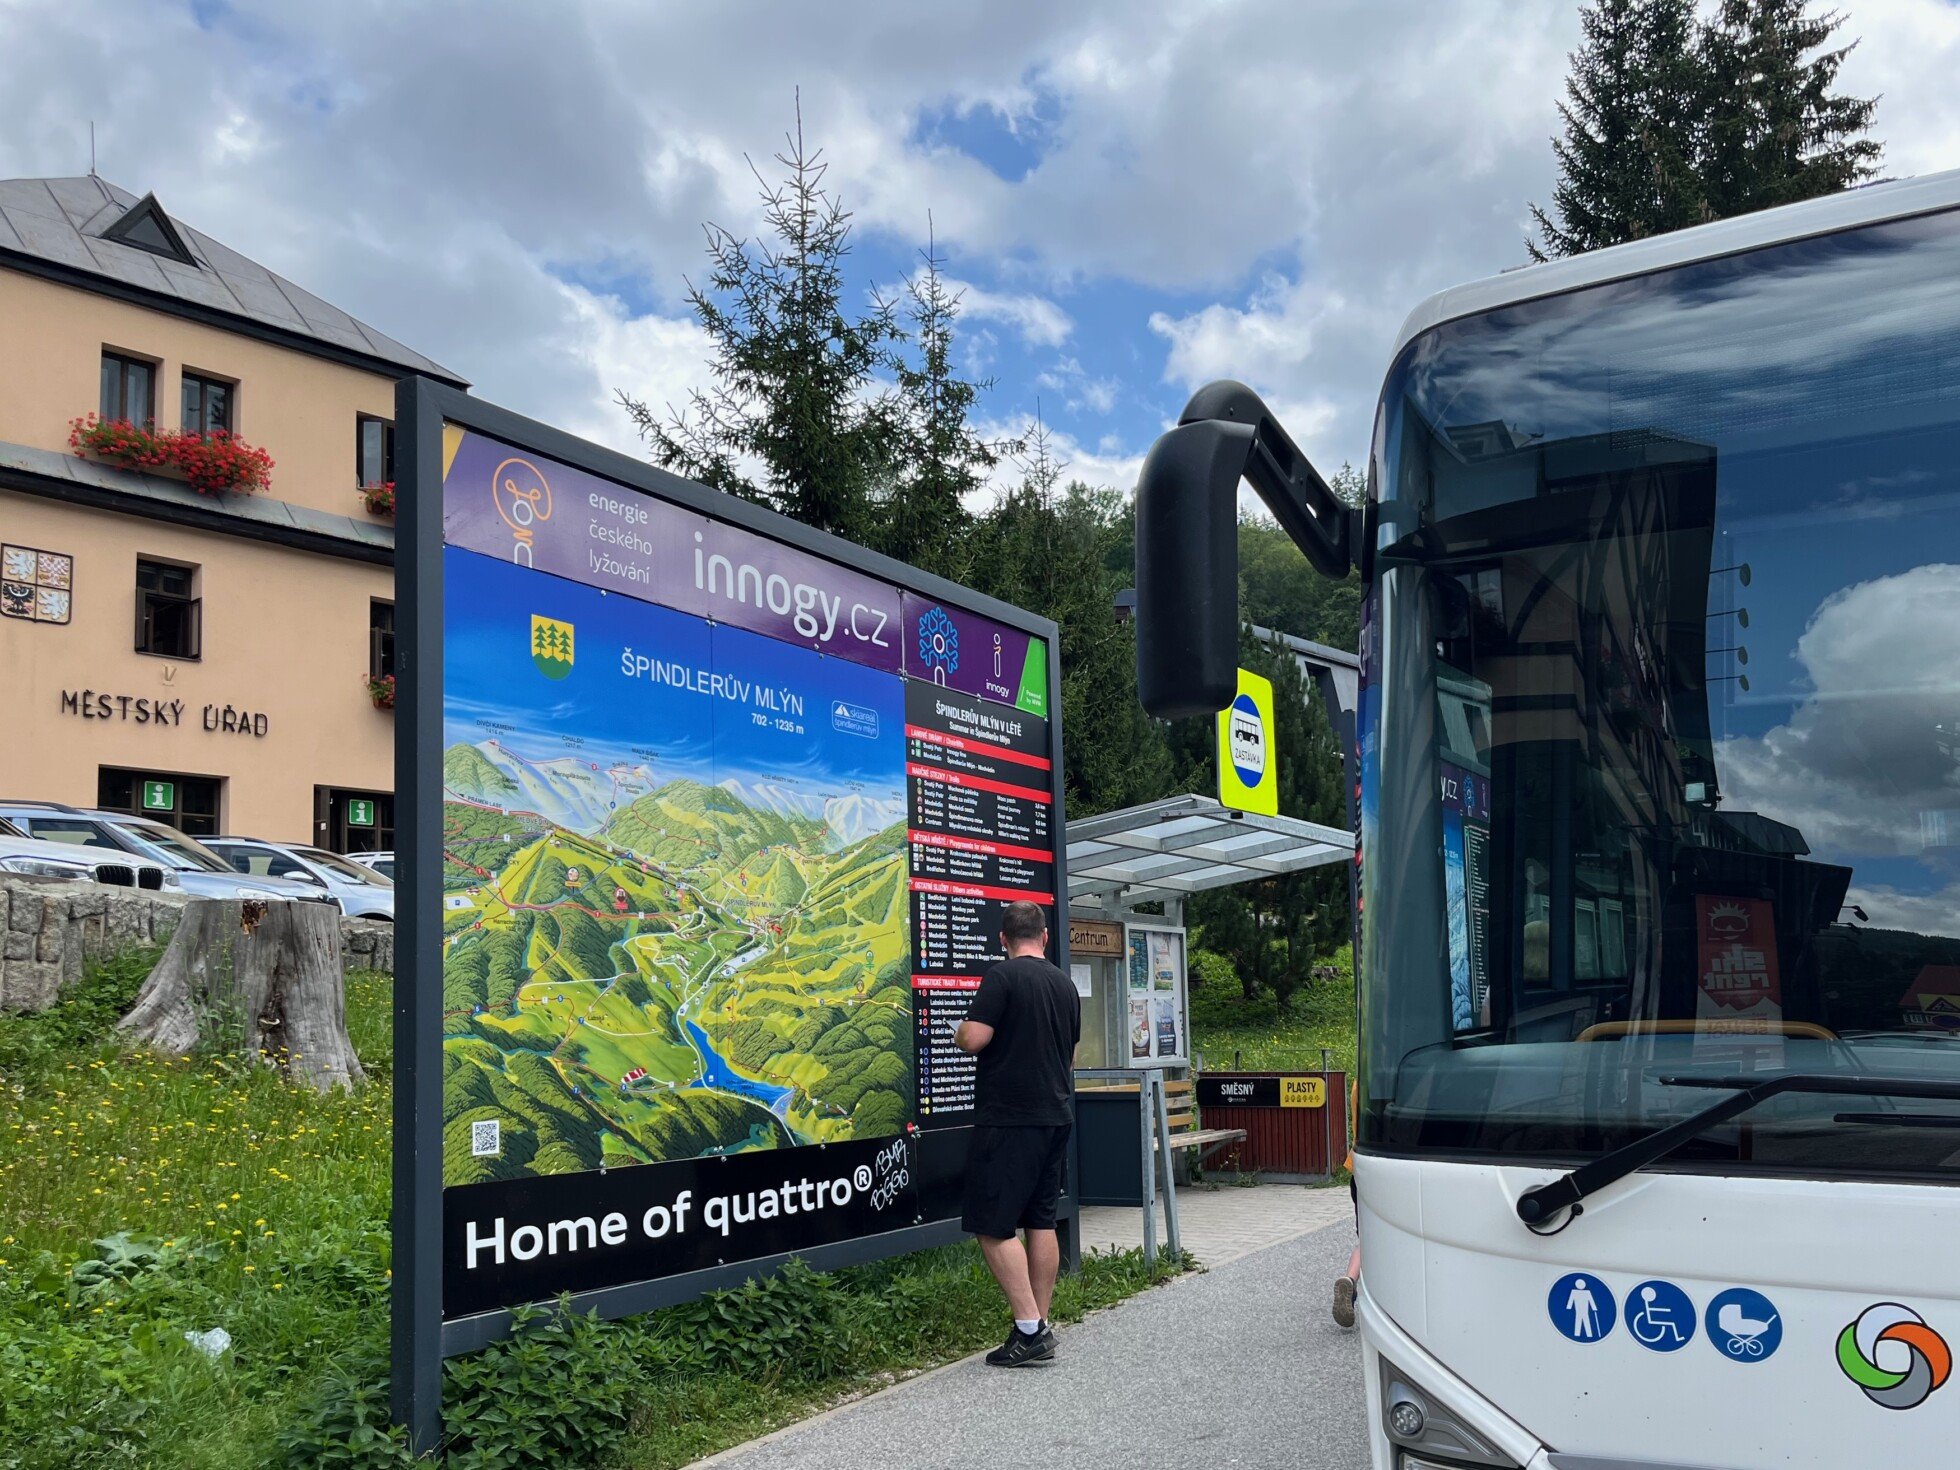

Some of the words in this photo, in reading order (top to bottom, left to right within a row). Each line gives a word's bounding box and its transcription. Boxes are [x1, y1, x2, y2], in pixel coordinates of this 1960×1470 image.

[589, 493, 648, 524] energie
[590, 519, 652, 555] českého
[590, 549, 649, 584] lyžování
[695, 531, 889, 647] innogy.cz
[621, 647, 750, 703] ŠPINDLERŮV
[755, 684, 803, 716] MLÝN
[986, 679, 1010, 698] innogy
[61, 689, 185, 725] MĚSTSKÝ
[203, 704, 268, 738] ÚŘAD
[752, 713, 767, 725] 702
[775, 719, 794, 732] 1235
[796, 725, 804, 734] m
[850, 708, 875, 723] skiareál
[936, 699, 978, 725] ŠPINDLERŮV
[980, 713, 999, 730] MLÝN
[1000, 720, 1005, 731] V
[1006, 720, 1022, 736] LÉTĚ
[950, 721, 969, 734] Summer
[1235, 748, 1260, 764] ZASTÁVKA
[1069, 927, 1108, 946] Centrum
[1221, 1082, 1254, 1095] SMĚSNÝ
[1287, 1082, 1316, 1093] PLASTY
[466, 1211, 627, 1269] Home
[643, 1190, 692, 1238] of
